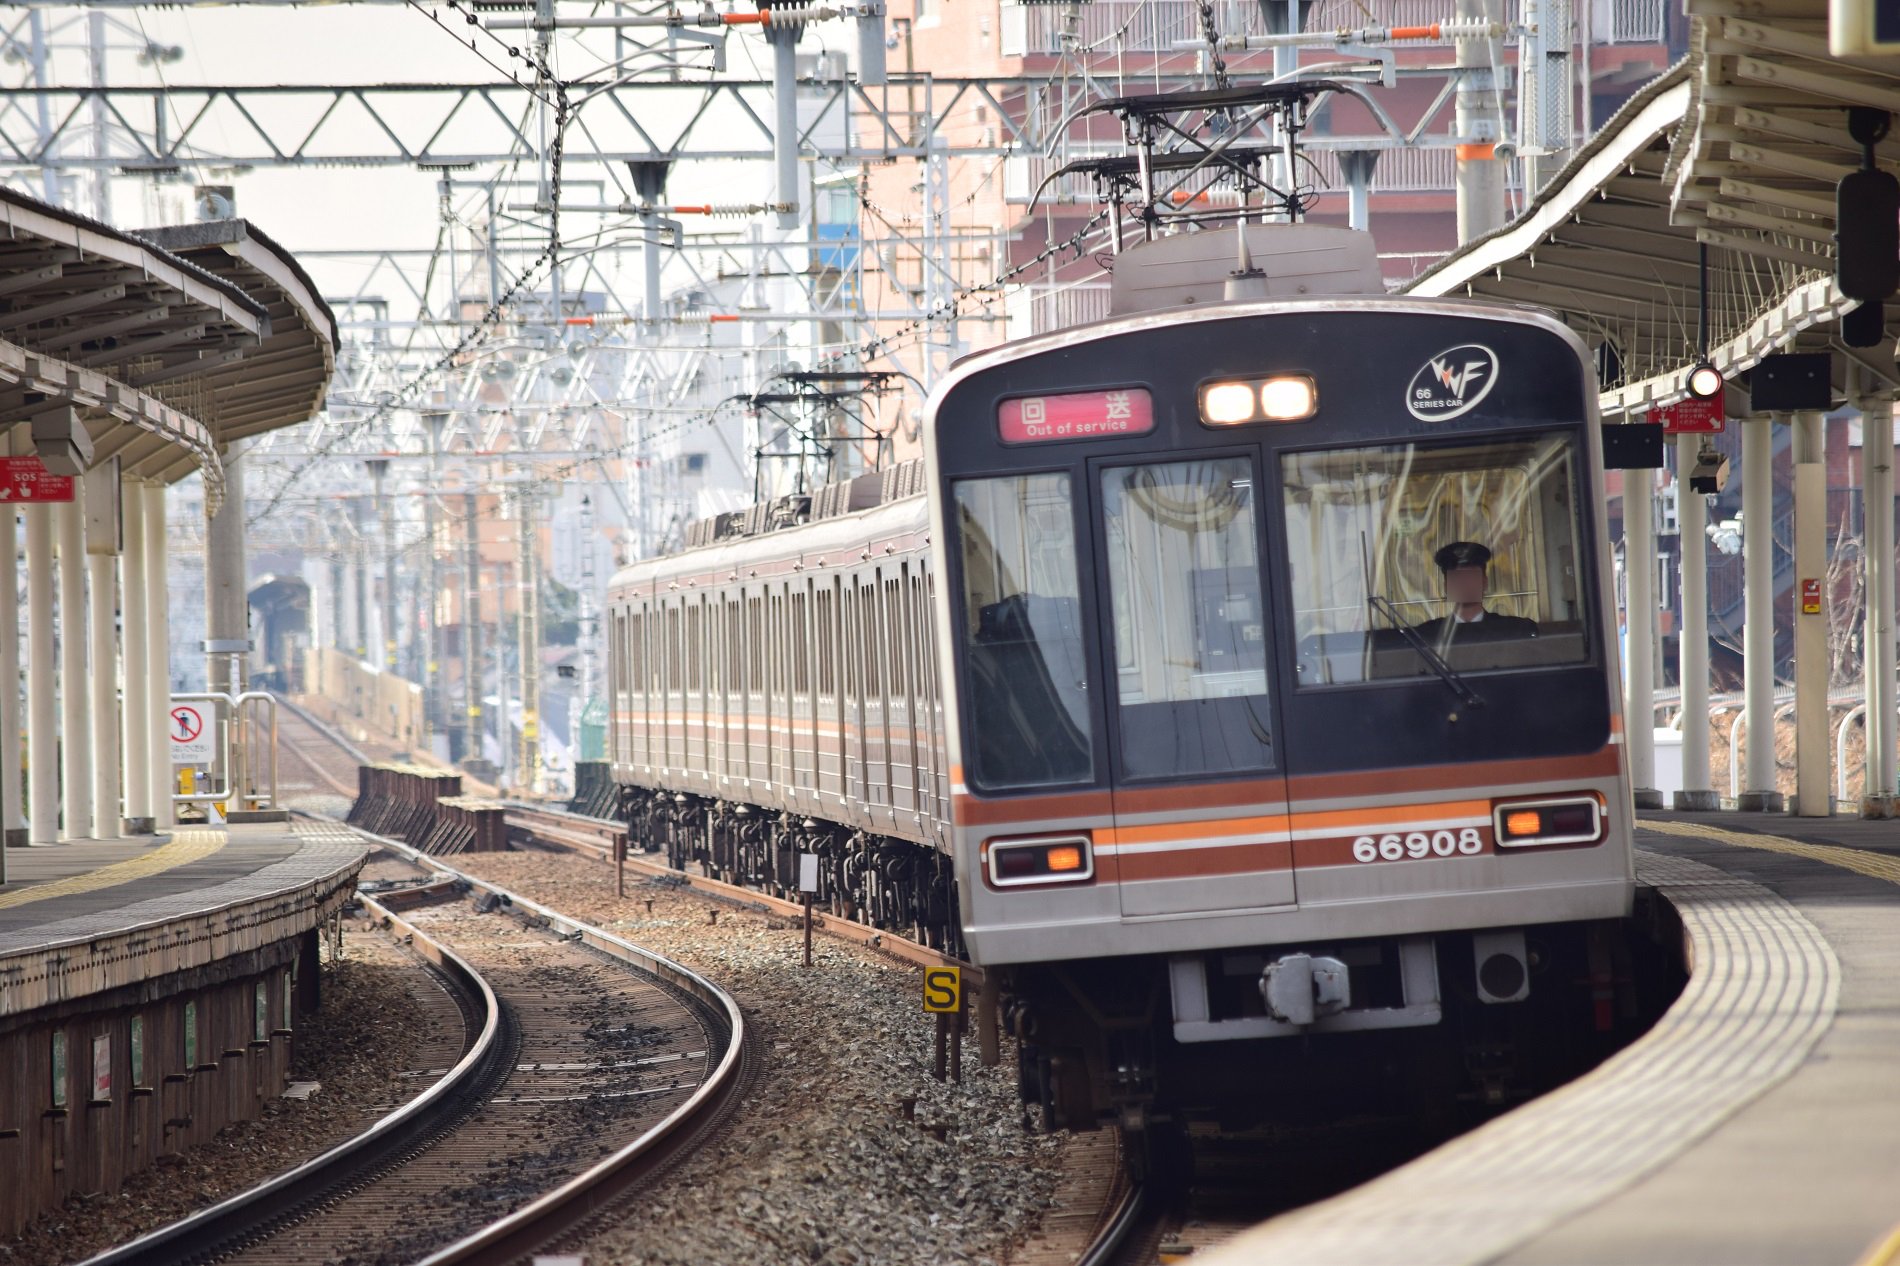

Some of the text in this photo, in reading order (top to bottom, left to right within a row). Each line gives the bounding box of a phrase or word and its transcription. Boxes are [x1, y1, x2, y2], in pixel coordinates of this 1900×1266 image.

[1416, 388, 1432, 399] 66
[1413, 399, 1463, 409] SERIES CAR
[1026, 419, 1127, 436] Out of service
[14, 473, 37, 482] SOS
[1352, 828, 1482, 863] 66908
[926, 971, 957, 1009] S
